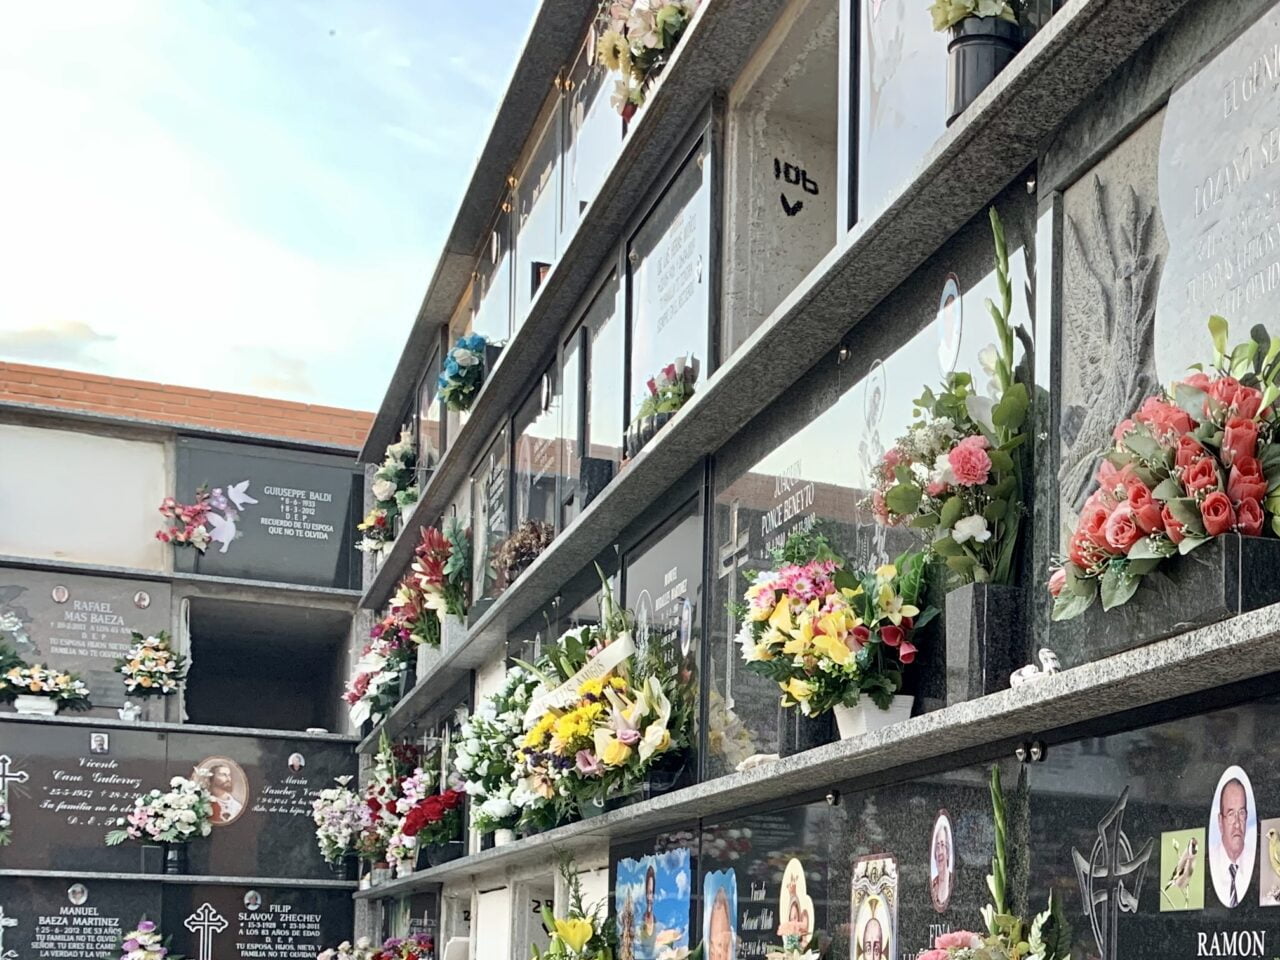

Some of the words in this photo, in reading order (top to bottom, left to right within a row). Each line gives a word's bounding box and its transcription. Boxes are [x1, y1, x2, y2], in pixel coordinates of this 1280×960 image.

[1192, 146, 1254, 219] LOZANO
[264, 485, 307, 499] GUIUSEPPE
[309, 491, 332, 503] BALDI
[761, 503, 783, 538] PONCE
[783, 482, 815, 522] BENEYTO
[260, 517, 293, 527] RECUERDO
[293, 521, 302, 529] DE
[302, 522, 311, 530] TU
[311, 523, 334, 533] ESPOSA
[268, 526, 283, 535] QUE
[283, 528, 295, 536] NO
[295, 529, 304, 537] TE
[304, 530, 329, 540] OLVIDA
[73, 600, 114, 613] RAFAEL
[64, 611, 88, 622] MAS
[90, 612, 125, 626] BAEZA
[78, 648, 88, 656] NO
[89, 649, 98, 657] TE
[78, 757, 119, 769] Vicente
[52, 770, 84, 782] Cano
[92, 772, 143, 789] Gutierrez
[280, 775, 308, 785] Maria
[261, 785, 297, 799] Sanchez
[55, 800, 92, 813] familia
[59, 906, 100, 916] MANUEL
[269, 904, 292, 913] FILIP
[38, 916, 69, 925] BAEZA
[72, 917, 121, 927] MARTINEZ
[238, 912, 274, 921] SLAVOV
[280, 913, 322, 922] ZHECHEV
[47, 934, 74, 942] FAMILIA
[271, 928, 290, 936] AÑOS
[1197, 930, 1266, 957] RAMON
[50, 950, 78, 958] VERDAD
[240, 950, 266, 958] FAMILIA
